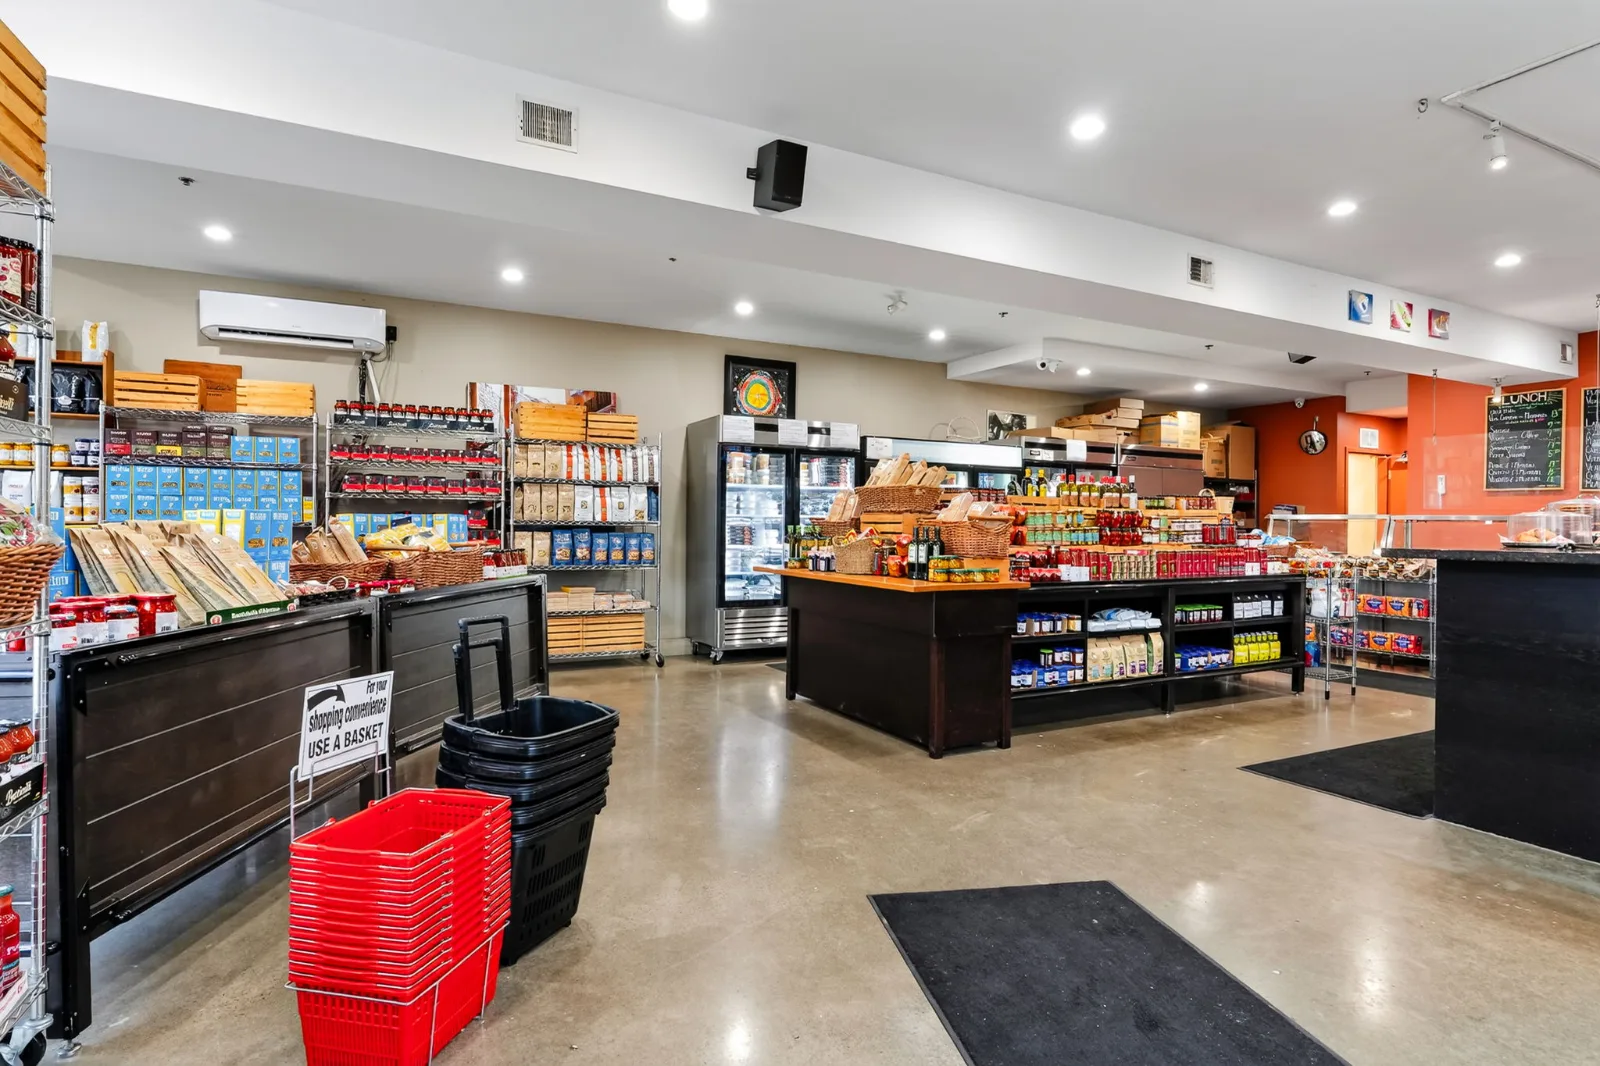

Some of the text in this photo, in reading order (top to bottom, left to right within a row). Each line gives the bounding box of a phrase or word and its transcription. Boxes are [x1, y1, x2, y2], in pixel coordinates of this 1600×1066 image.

[1501, 391, 1547, 406] LUNCH
[366, 679, 388, 695] For your
[308, 696, 387, 734] shopping convenience
[308, 721, 384, 759] USE A BASKET
